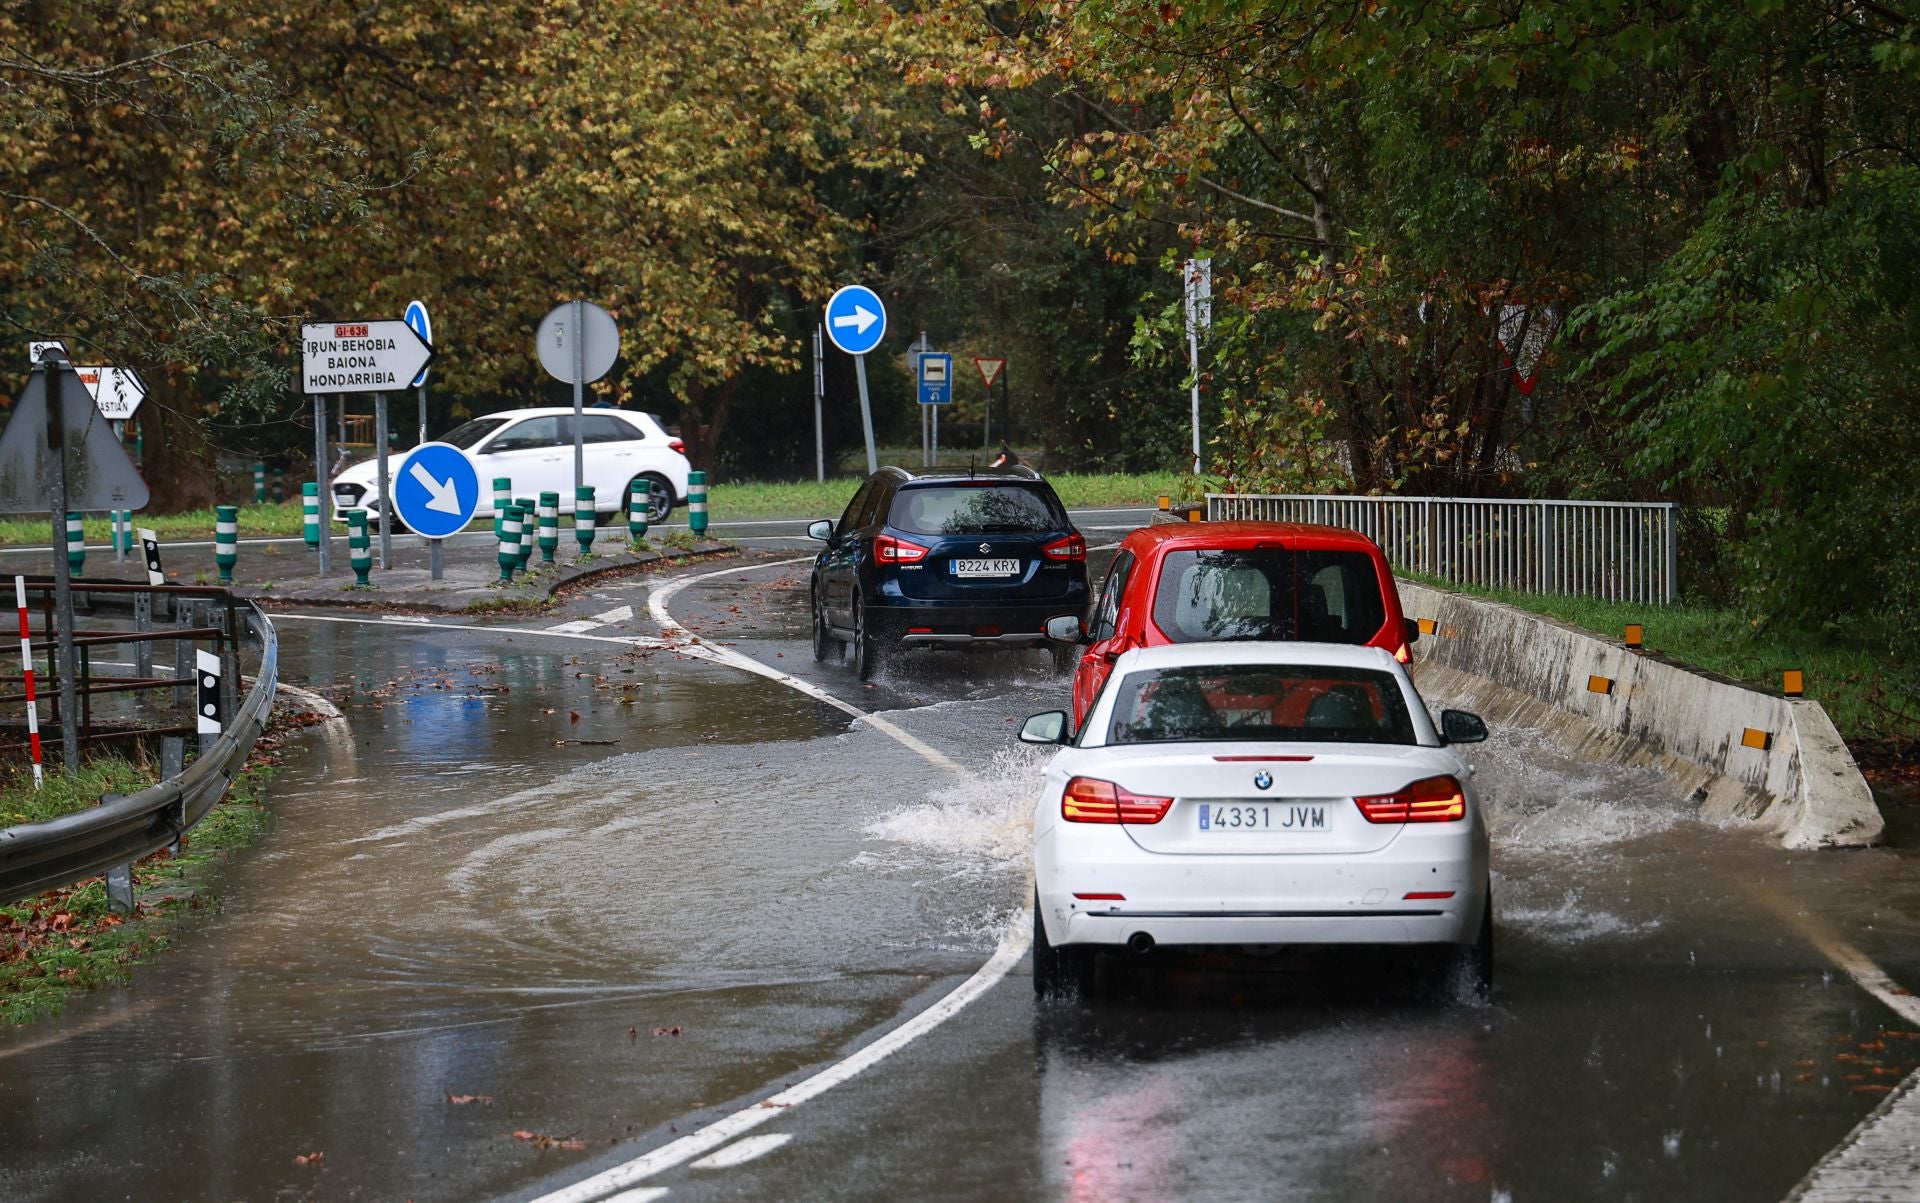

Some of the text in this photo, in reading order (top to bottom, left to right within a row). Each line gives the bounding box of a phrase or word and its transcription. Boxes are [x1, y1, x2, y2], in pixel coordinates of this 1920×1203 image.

[336, 326, 368, 336] GI-636
[307, 339, 396, 353] IRUN-BEHOBIA
[328, 356, 376, 369] BAIONA
[309, 372, 396, 386] HONDARRIBIA
[958, 560, 990, 572] 8224
[993, 560, 1017, 572] KRX
[1214, 806, 1270, 828] 4331
[1282, 806, 1325, 828] JVM
